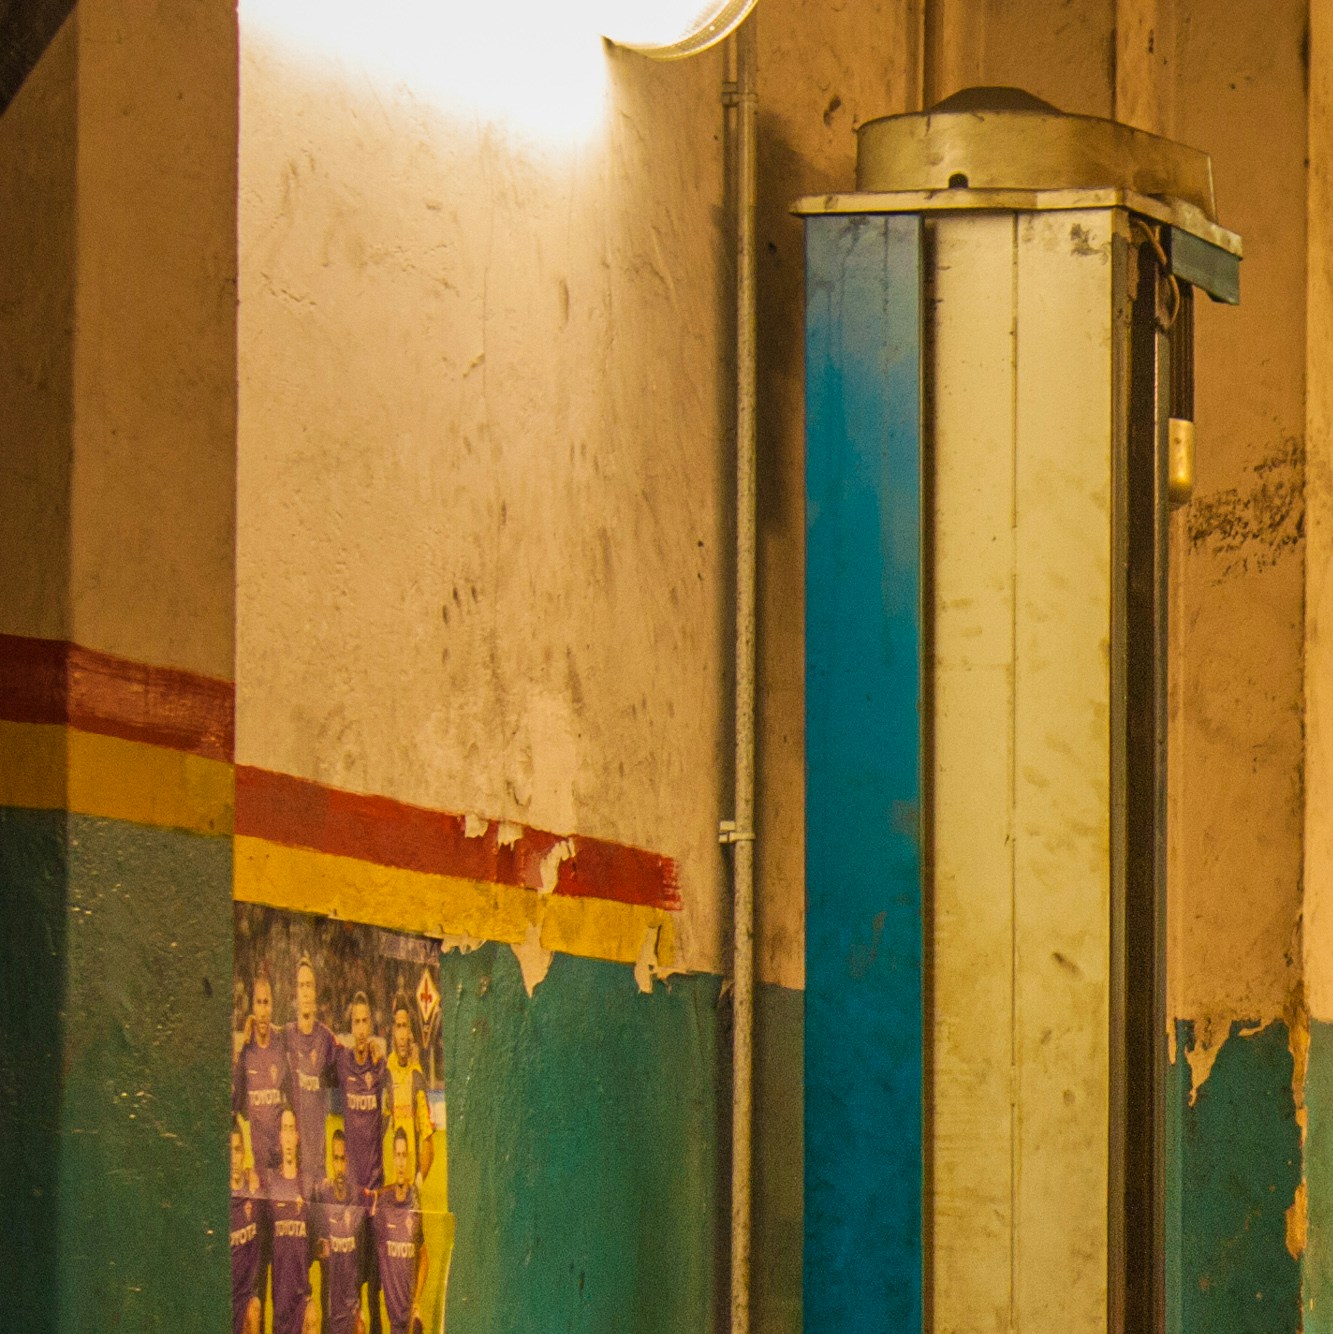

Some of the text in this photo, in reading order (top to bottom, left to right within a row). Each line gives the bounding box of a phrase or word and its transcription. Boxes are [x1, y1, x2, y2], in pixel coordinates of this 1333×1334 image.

[347, 1093, 377, 1111] TOYOTA
[275, 1219, 307, 1237] TOYOTA
[387, 1240, 415, 1258] TOYOTA
